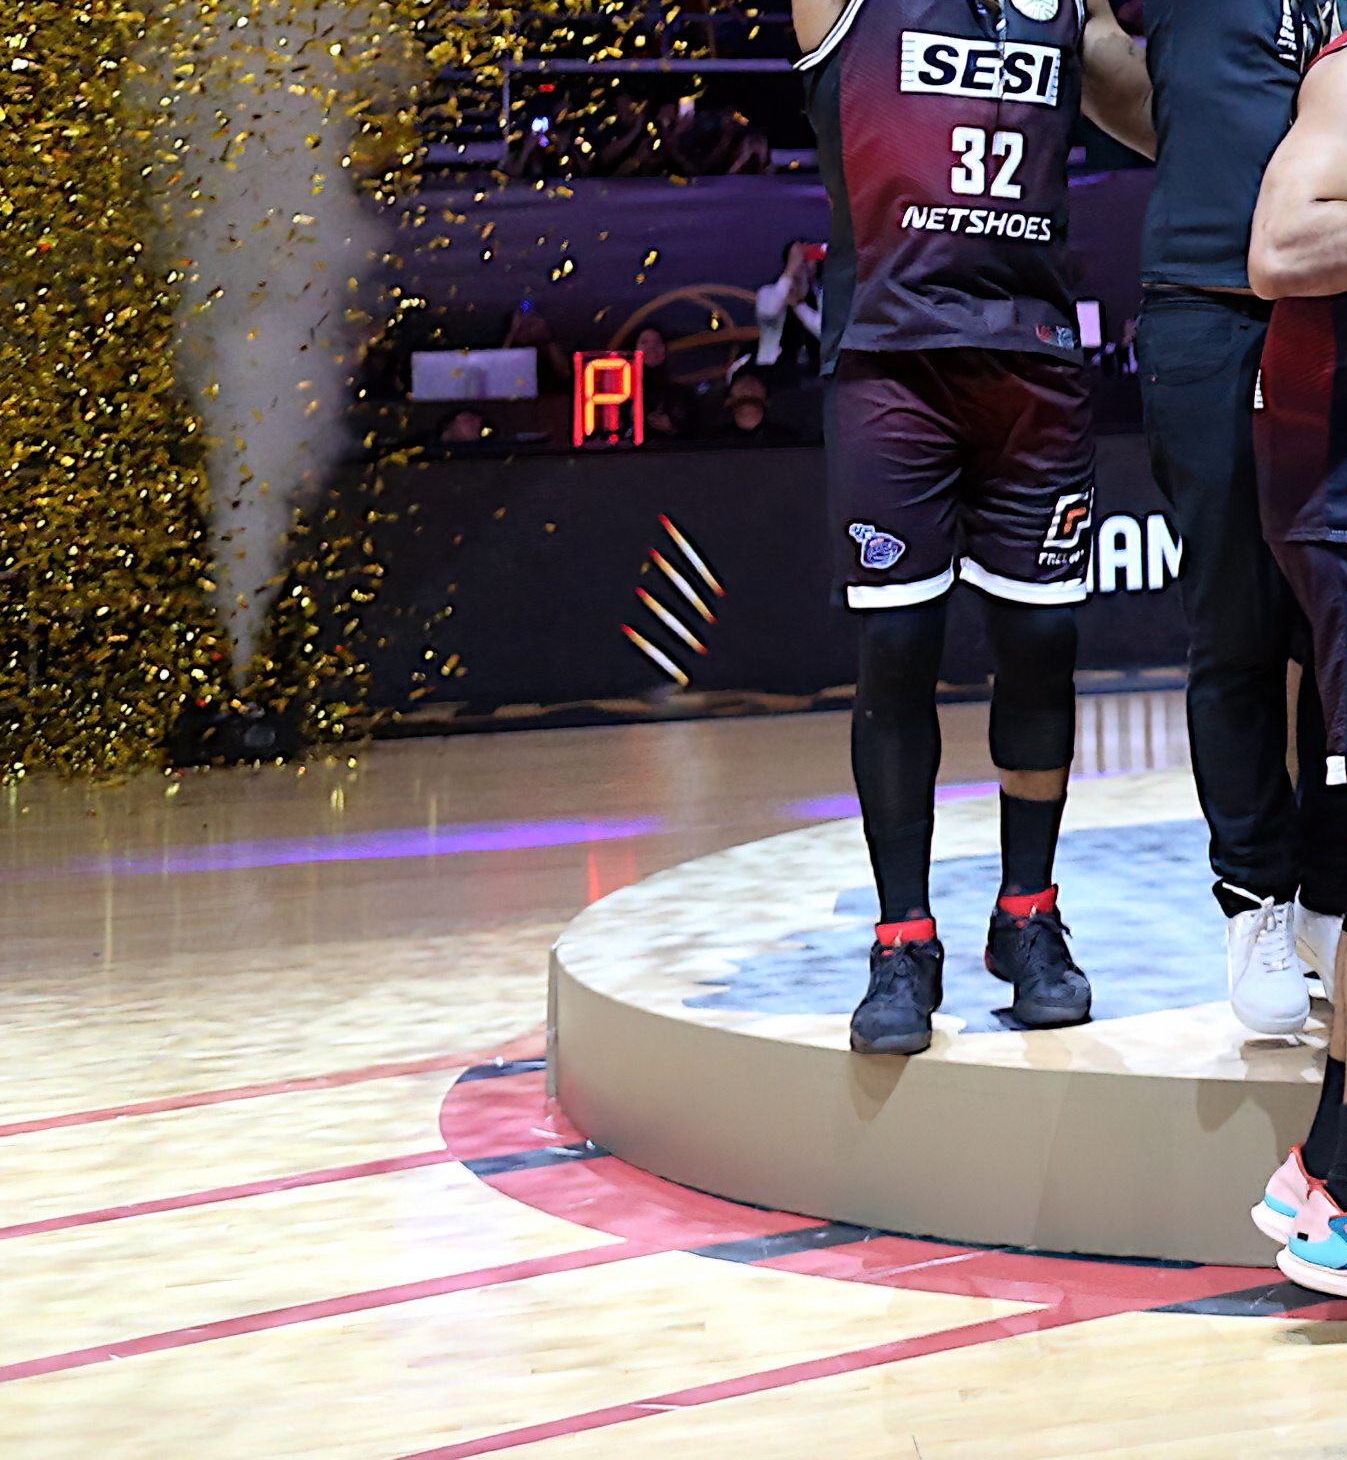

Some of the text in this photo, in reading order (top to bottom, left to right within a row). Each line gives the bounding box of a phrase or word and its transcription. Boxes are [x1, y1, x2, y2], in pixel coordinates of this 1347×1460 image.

[918, 44, 1055, 96] SESI
[951, 126, 1024, 200] 32
[901, 205, 1052, 243] NETSHOES
